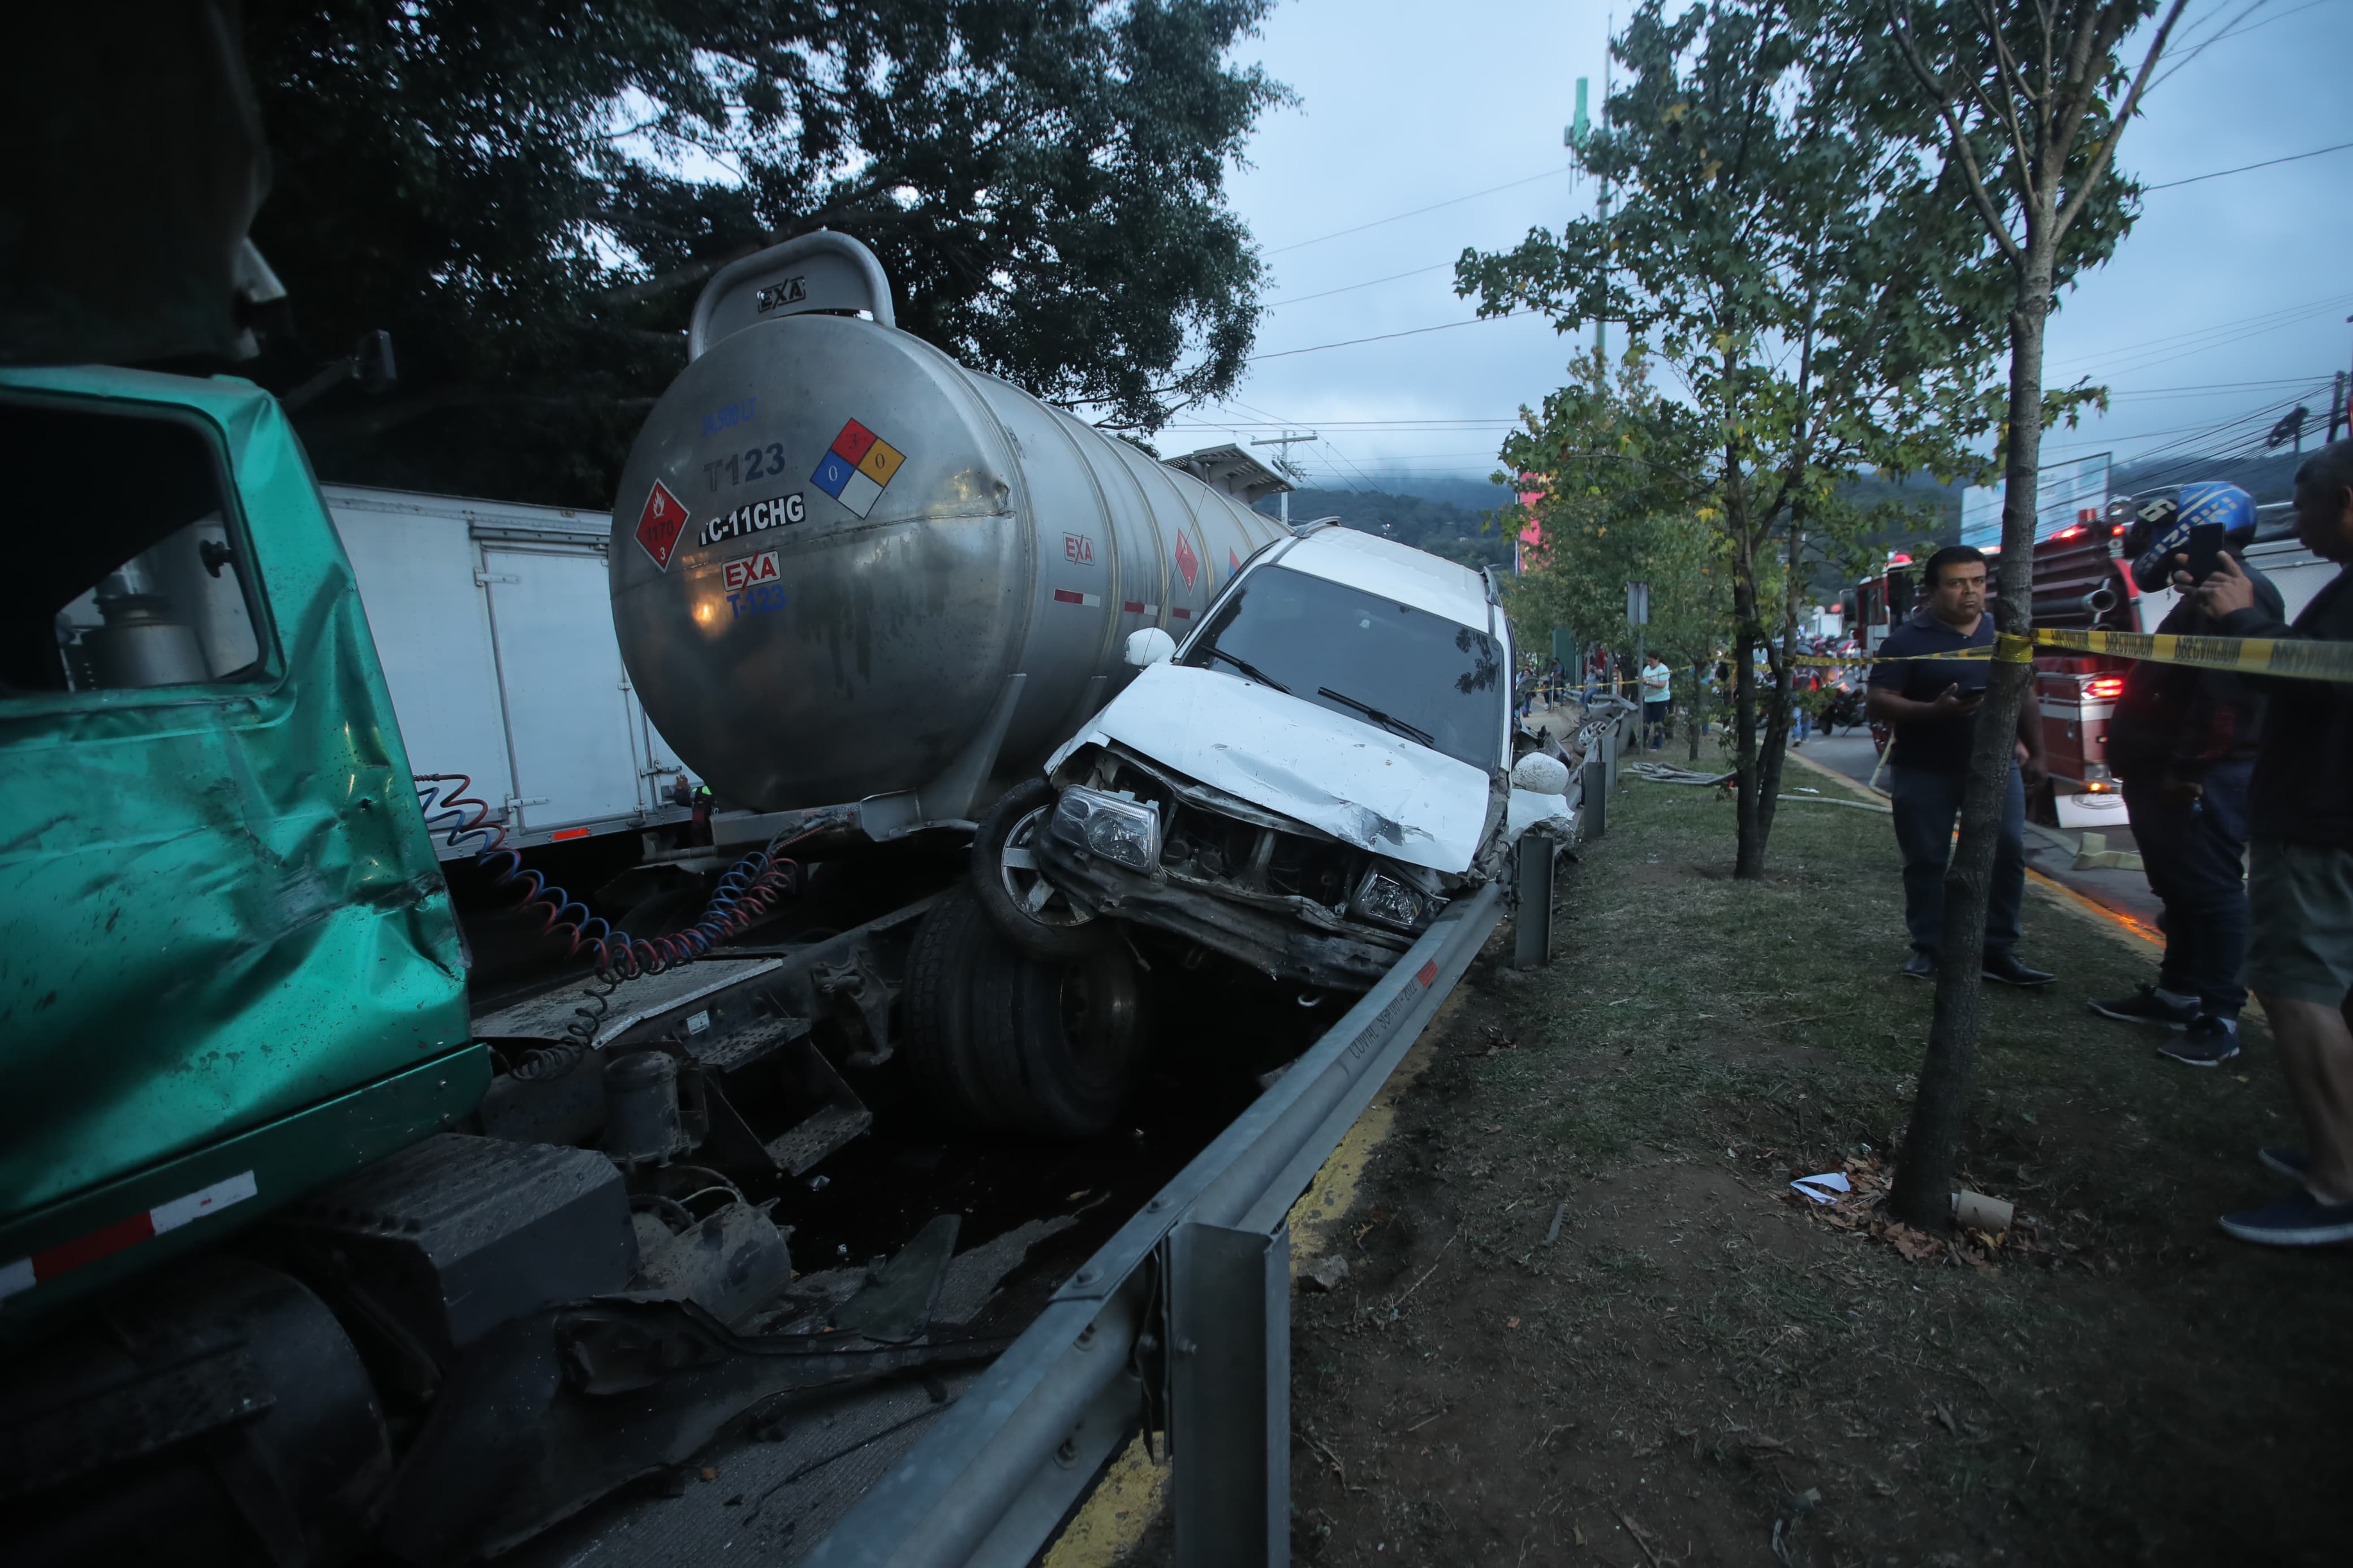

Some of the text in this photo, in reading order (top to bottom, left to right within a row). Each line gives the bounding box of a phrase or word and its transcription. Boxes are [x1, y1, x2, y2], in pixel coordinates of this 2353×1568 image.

[761, 278, 803, 309] EXA
[849, 433, 857, 450] 3
[703, 442, 786, 493] T123
[828, 465, 838, 481] 0
[875, 453, 885, 469] 0
[647, 519, 674, 544] 1170
[660, 547, 666, 560] 3
[1065, 534, 1093, 565] EXA
[725, 551, 777, 591] EXA
[726, 583, 787, 619] T-123
[1348, 1025, 1380, 1059] COVIAL
